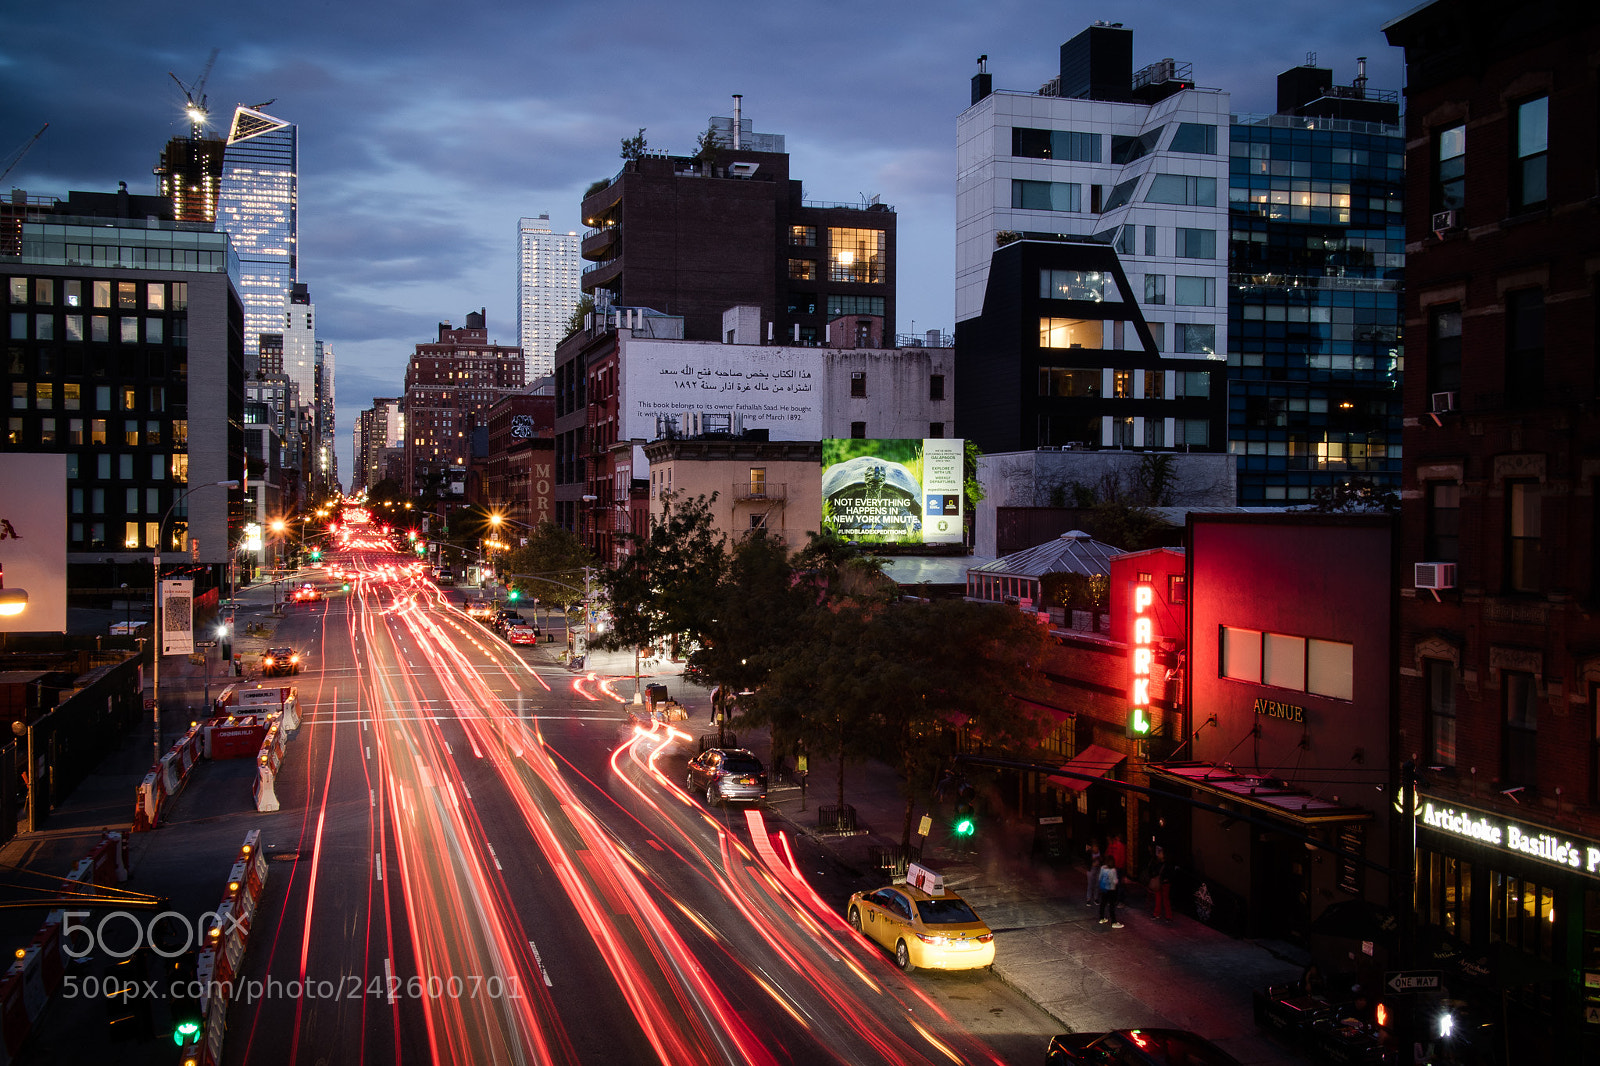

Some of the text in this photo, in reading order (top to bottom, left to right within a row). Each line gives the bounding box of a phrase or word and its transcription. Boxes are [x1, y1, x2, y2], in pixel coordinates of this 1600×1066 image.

[681, 363, 694, 375] الله
[697, 367, 711, 379] فتح
[714, 368, 742, 378] صاحبه
[799, 369, 811, 378] هذا
[746, 369, 769, 380] يخص
[772, 369, 796, 380] الكتاب
[674, 380, 697, 389] ١٨٩٢
[700, 380, 717, 390] سنة
[754, 382, 769, 391] ماله
[772, 384, 784, 393] من
[787, 383, 812, 393] اشتراه
[638, 400, 652, 408] This
[671, 402, 695, 410] belongs
[736, 403, 762, 411] Fathallah
[791, 405, 812, 413] bought
[535, 463, 551, 538] MORA
[834, 498, 911, 507] NOT EVERYTHING
[846, 506, 898, 515] HAPPENS IN
[823, 515, 920, 524] A NEW YORK MINUTE.
[1134, 585, 1153, 705] PARK
[1253, 698, 1303, 723] AVENUE
[1423, 802, 1502, 845] Artichoke
[1507, 825, 1580, 868] Basille's
[1395, 976, 1435, 988] ONE WAY
